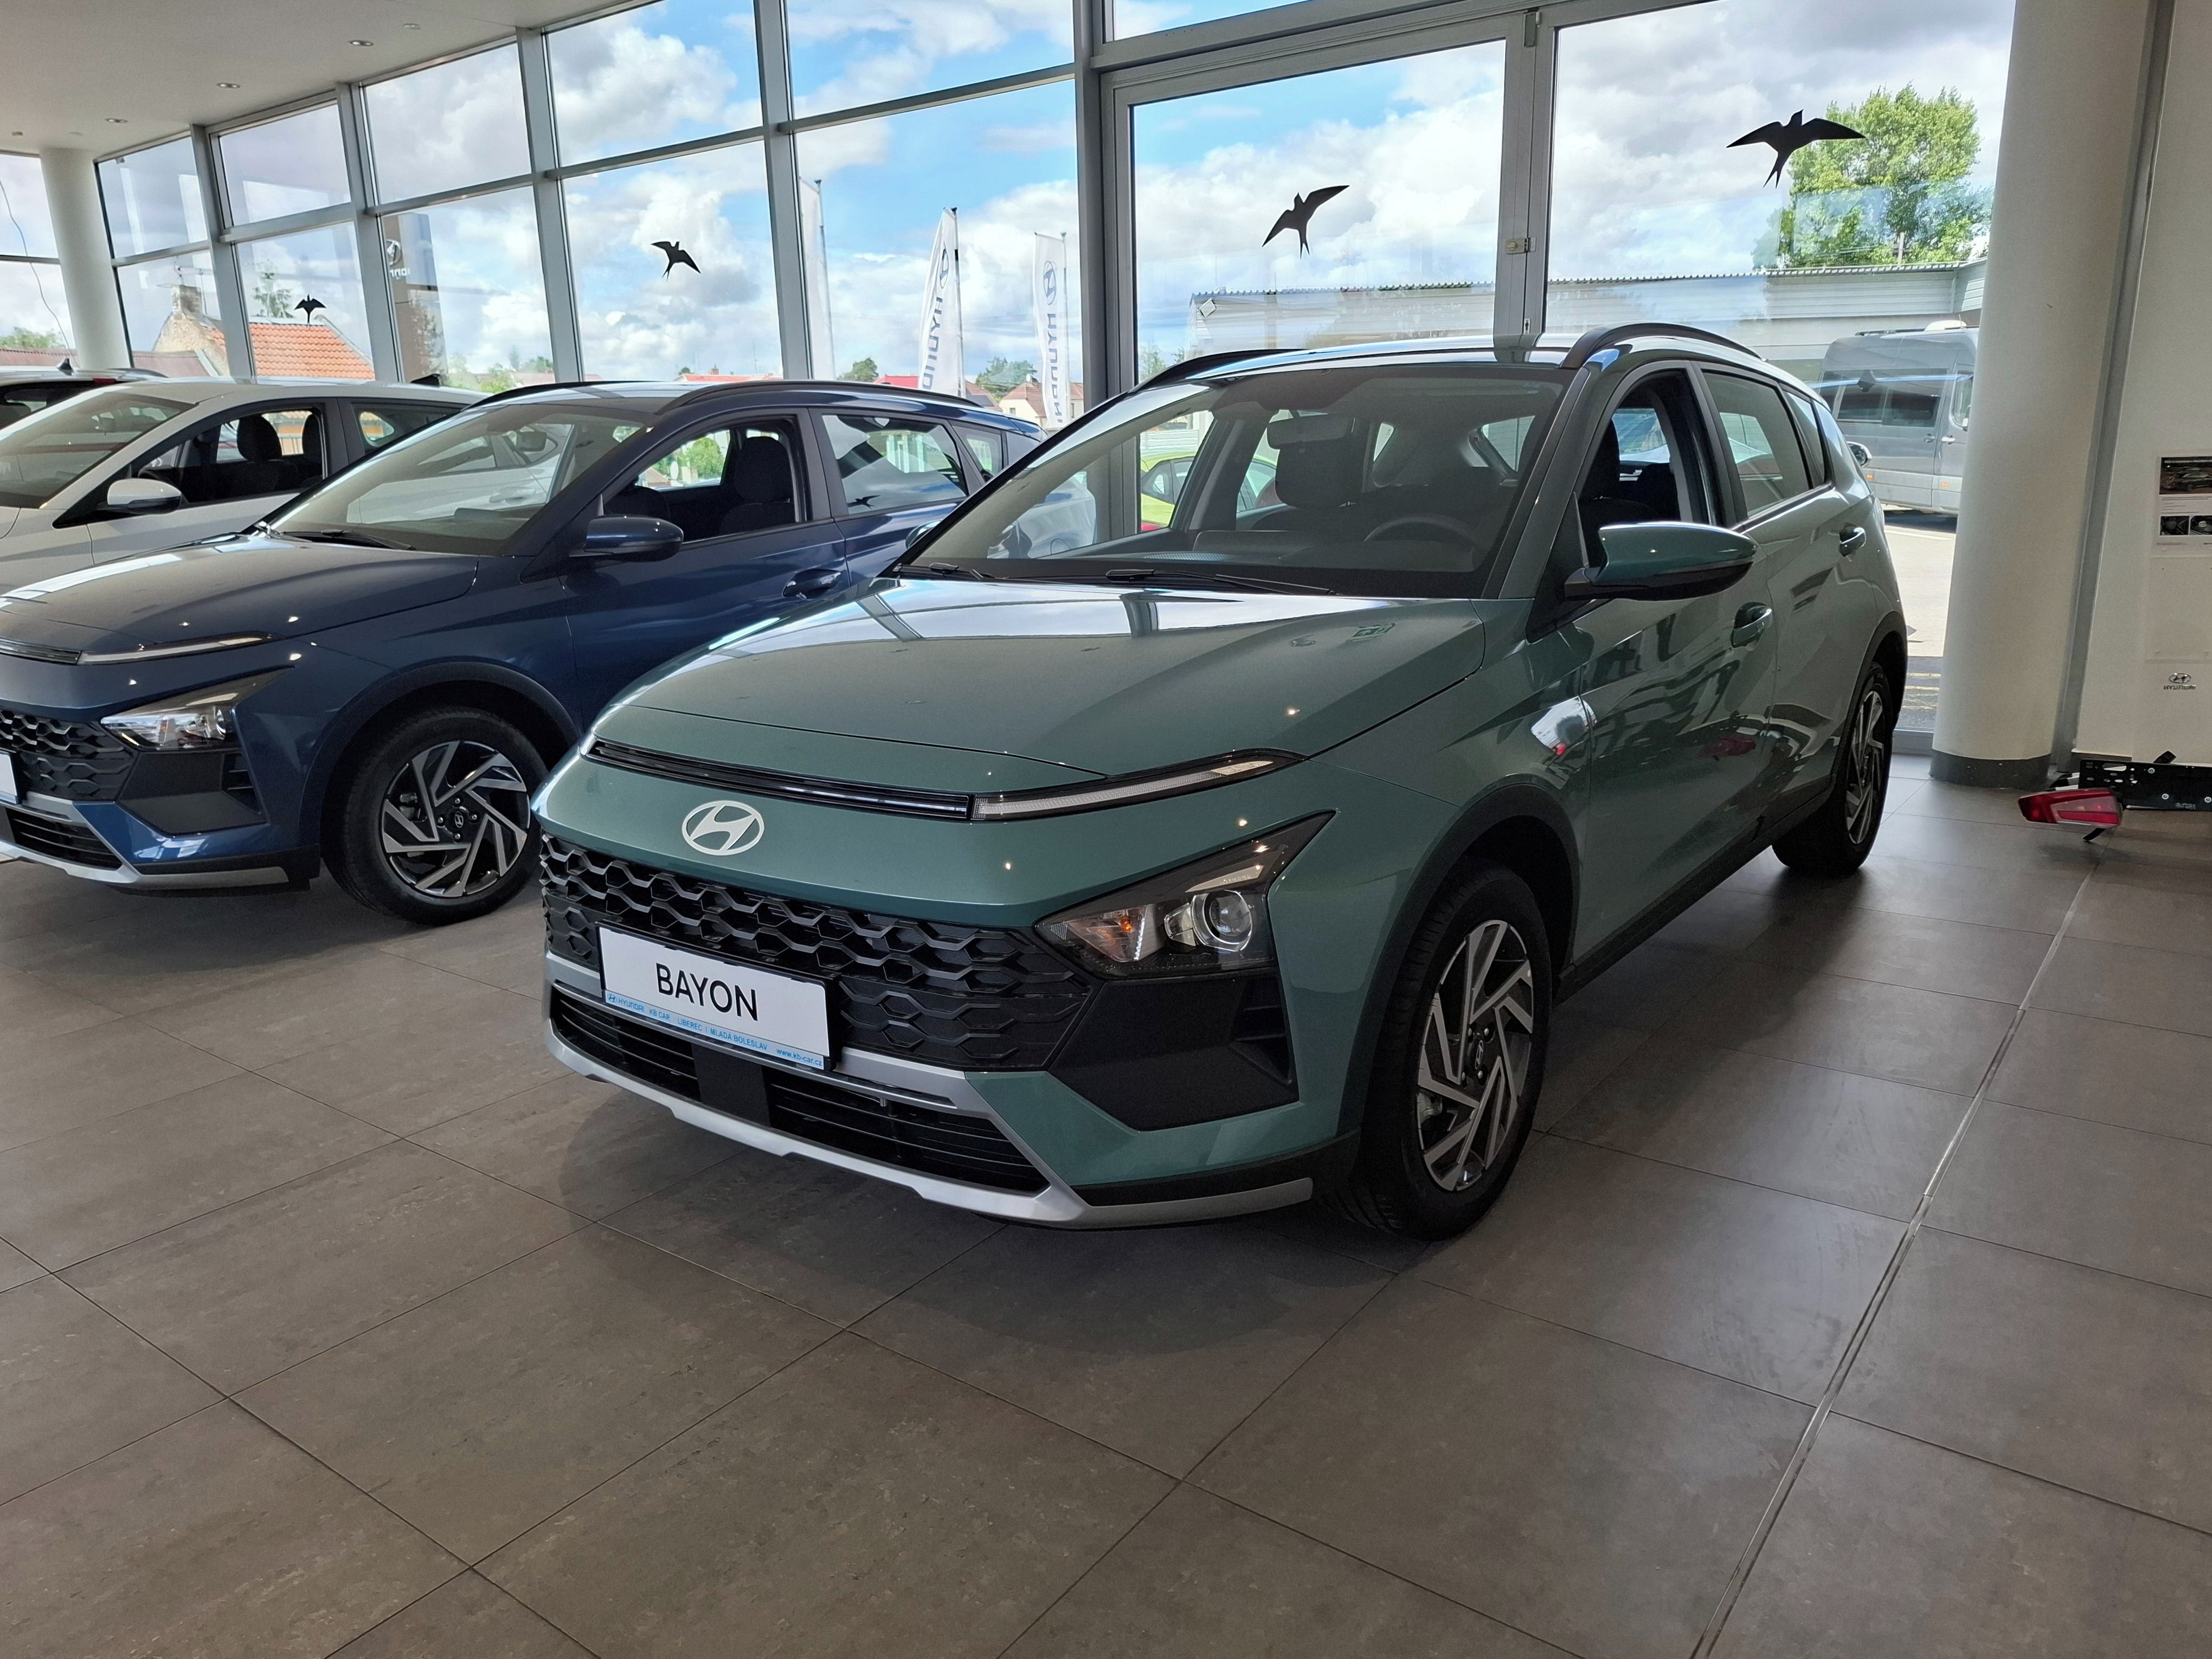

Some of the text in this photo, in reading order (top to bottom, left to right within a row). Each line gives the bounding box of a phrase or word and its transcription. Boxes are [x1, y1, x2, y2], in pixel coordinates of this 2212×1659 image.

[656, 962, 758, 1021] BAYON
[618, 998, 645, 1012] HYUNDAI
[649, 1008, 657, 1017] KB
[658, 1011, 671, 1020] CAR
[677, 1017, 703, 1031] LIBEREC
[710, 1027, 732, 1040] MLADÁ
[734, 1035, 768, 1051] BOLESLAV
[776, 1048, 822, 1066] www.kb-car.cz
